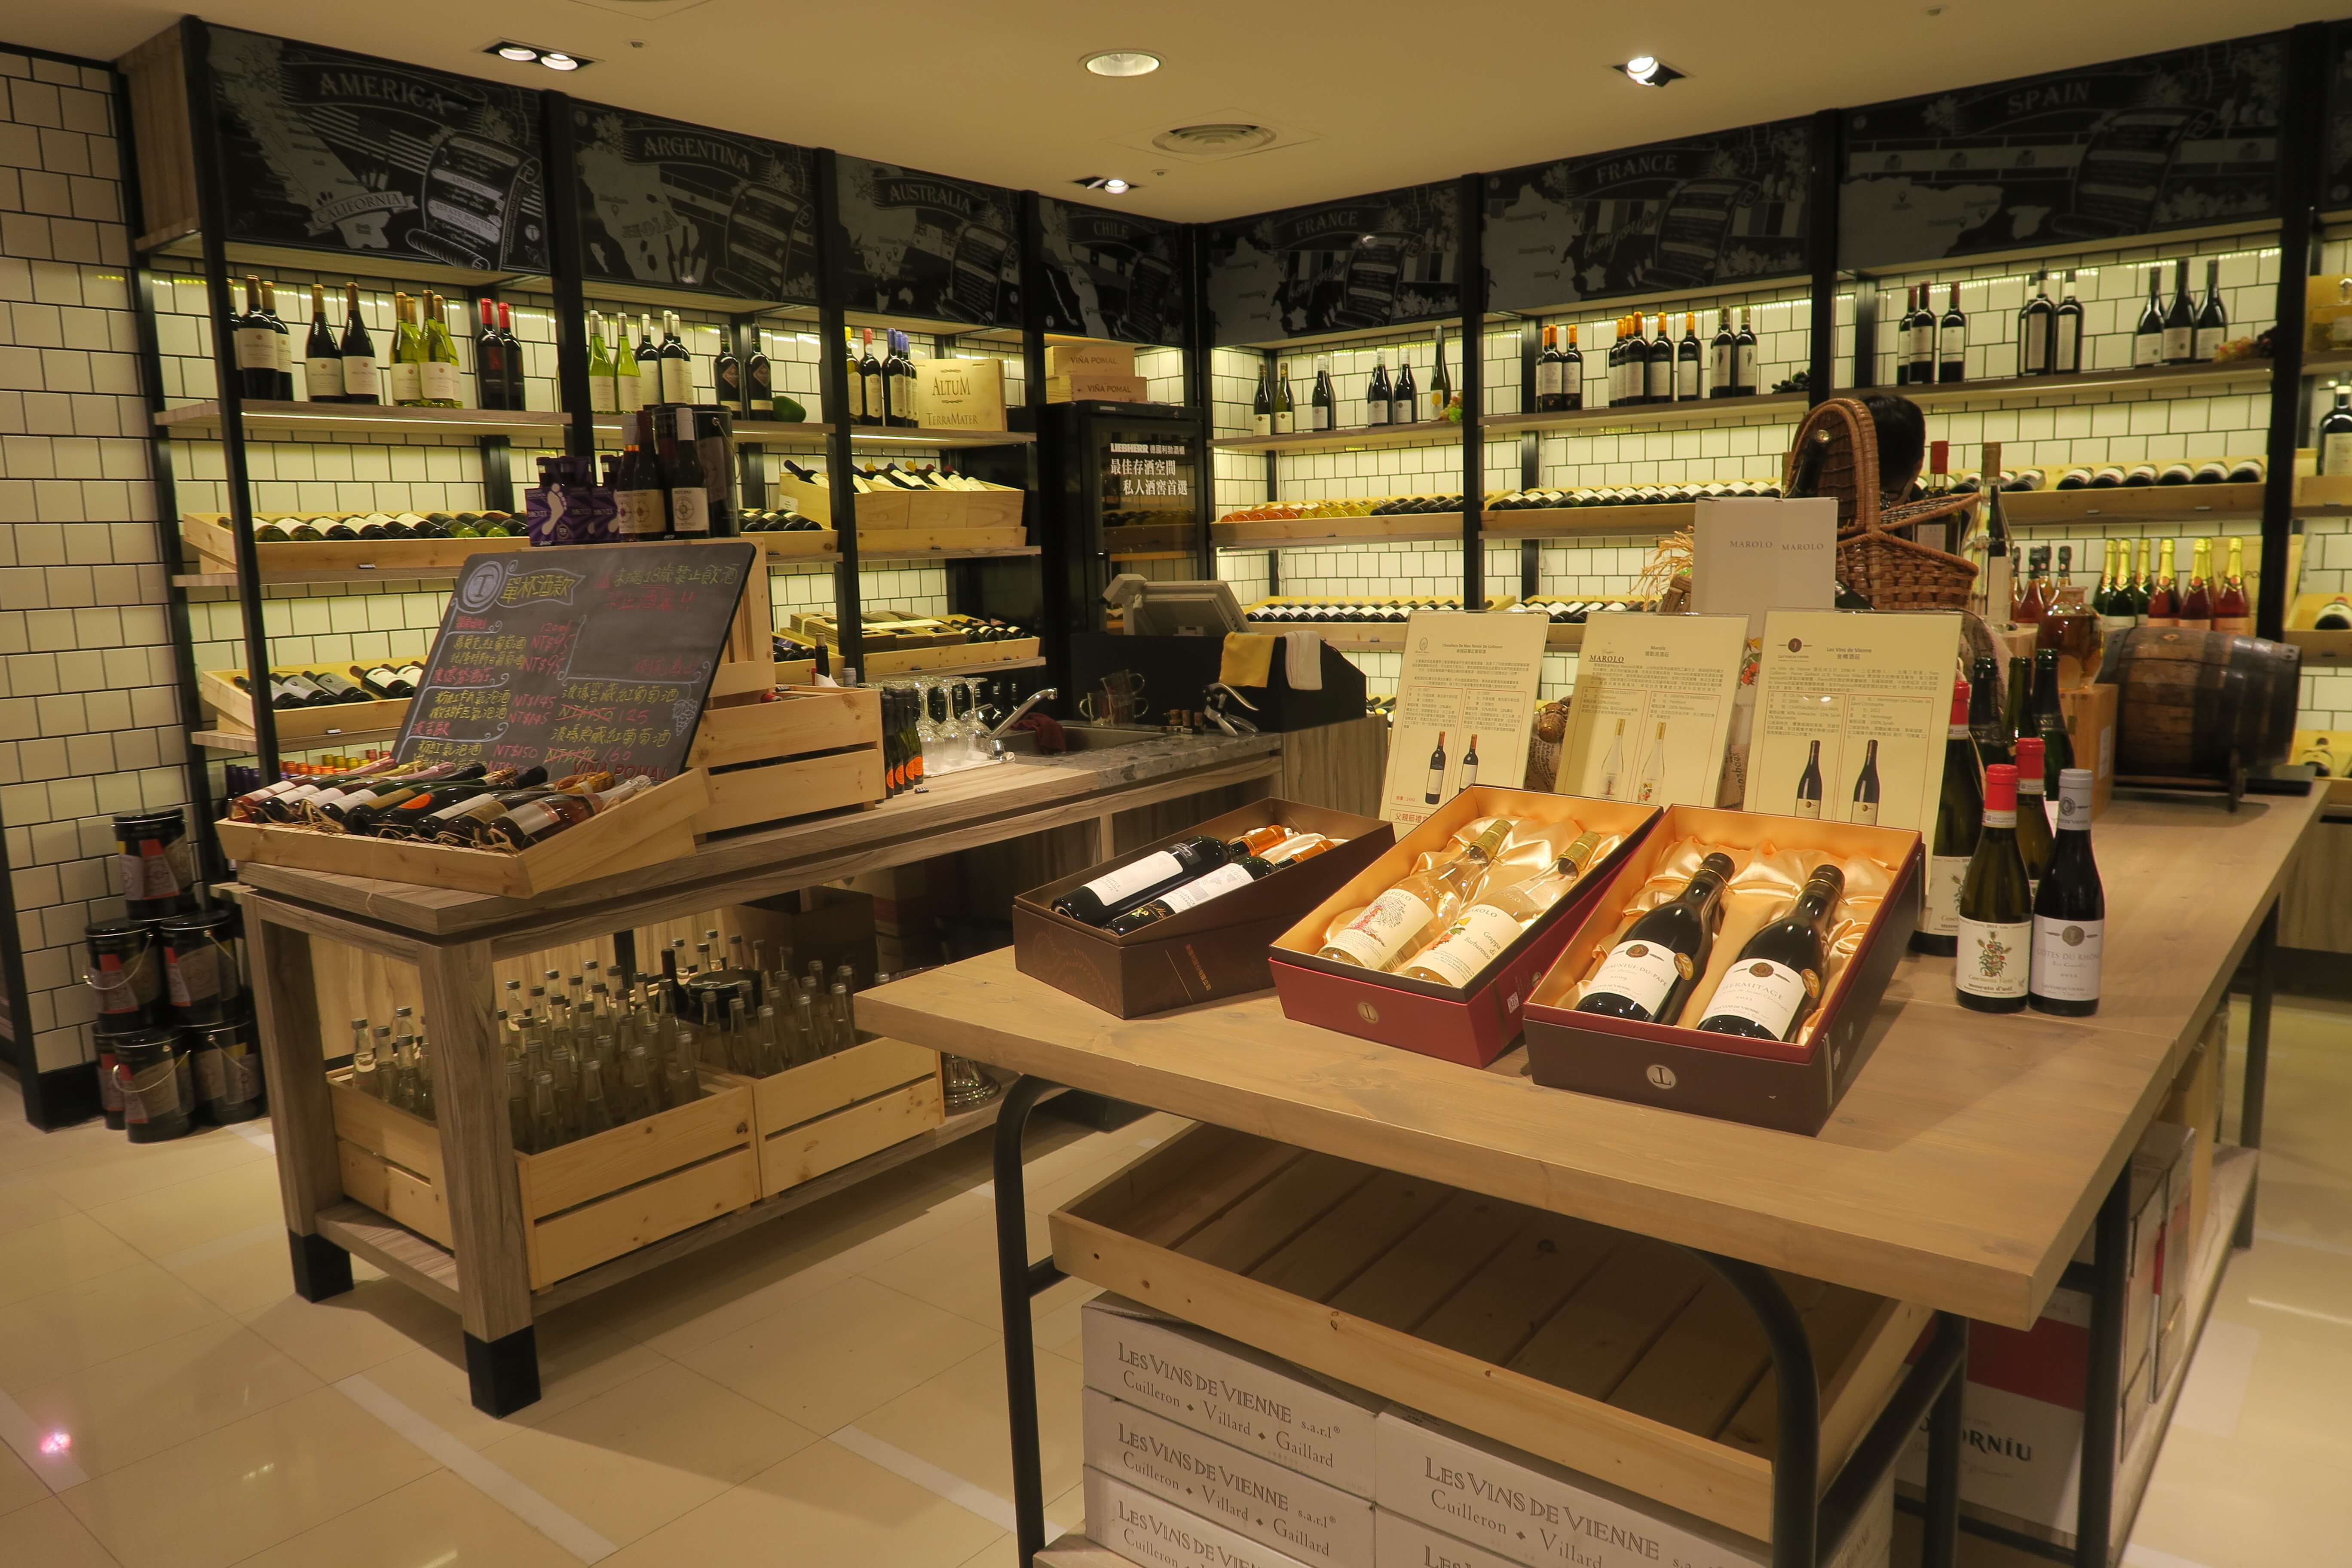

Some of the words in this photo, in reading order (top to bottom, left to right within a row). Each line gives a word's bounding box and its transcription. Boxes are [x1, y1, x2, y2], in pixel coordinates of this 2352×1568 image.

[320, 72, 447, 117] AMERICA
[2008, 82, 2091, 115] SPAIN
[644, 137, 750, 174] ARGENTINA
[1596, 154, 1678, 185] FRANCE
[316, 192, 402, 224] CALIFORNIA
[890, 184, 971, 214] AUSTRALIA
[1093, 220, 1129, 239] CHILE
[1295, 211, 1358, 238] FRANCE
[1071, 356, 1089, 364] VIÑA
[1087, 384, 1106, 393] VIÑA
[1110, 443, 1149, 454] LIEBHERR
[1110, 458, 1176, 476] 最佳存酒空間
[1123, 479, 1188, 496] 私人酒窖首選
[1730, 540, 1773, 548] MAROLO
[1782, 543, 1824, 551] MAROLO
[1589, 655, 1625, 663] MAROLO
[1464, 936, 1491, 960] Barbaresco
[1483, 931, 1501, 951] Grappa
[1721, 982, 1783, 1001] HERMITAGE
[1118, 1341, 1148, 1370] LES
[1149, 1354, 1193, 1387] VINS
[1196, 1374, 1218, 1396] DE
[1220, 1380, 1292, 1424] VIENNE
[1123, 1370, 1181, 1408] Cuilleron
[1203, 1400, 1250, 1436] Villard
[1275, 1430, 1334, 1468] Gaillard
[1118, 1422, 1148, 1452] LES
[1148, 1436, 1191, 1471] VINS
[1194, 1458, 1216, 1482] DE
[1218, 1465, 1289, 1511] VIENNE
[1123, 1451, 1179, 1490] Cuilleron
[1202, 1485, 1249, 1522] Villard
[1273, 1518, 1329, 1556] Gaillard
[1425, 1456, 1465, 1489] LES
[1467, 1471, 1526, 1512] VINS
[1530, 1496, 1559, 1525] DE
[1563, 1506, 1660, 1561] VIENNE
[1118, 1500, 1148, 1530] LES
[1148, 1515, 1191, 1550] VINS
[1193, 1537, 1214, 1561] DE
[1431, 1488, 1507, 1534] Cuilleron
[1539, 1528, 1603, 1568] Villard
[1124, 1528, 1179, 1568] Cuilleron
